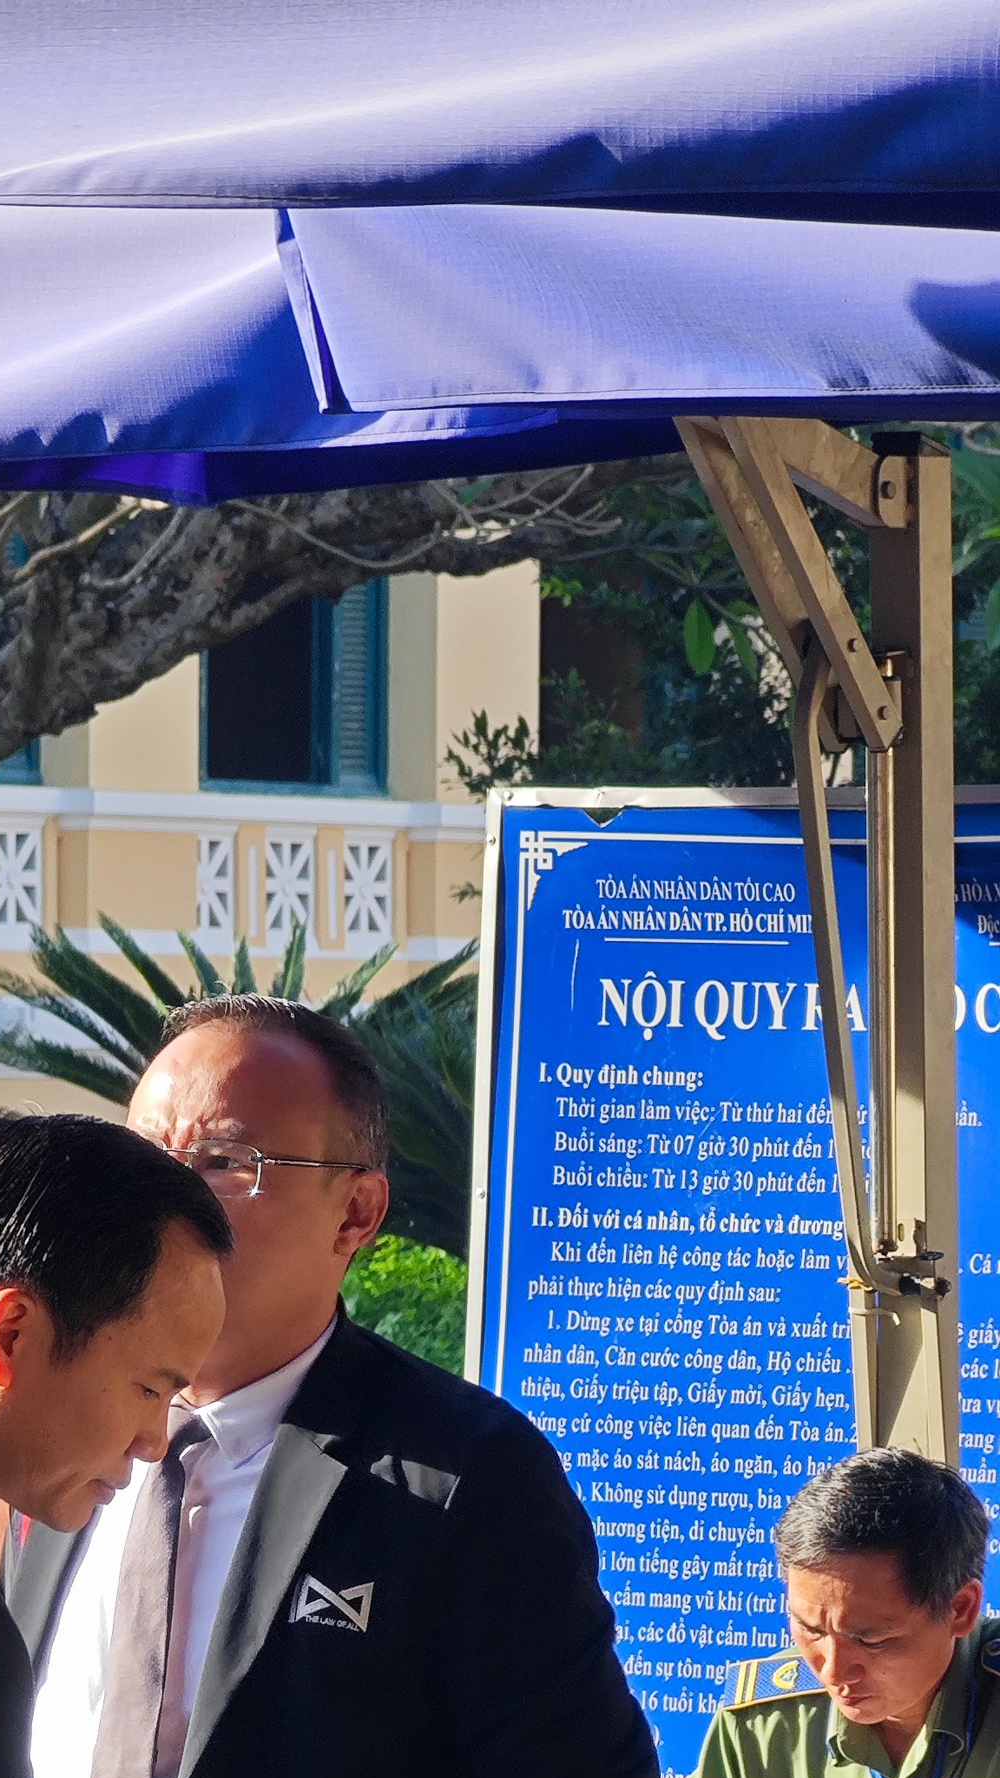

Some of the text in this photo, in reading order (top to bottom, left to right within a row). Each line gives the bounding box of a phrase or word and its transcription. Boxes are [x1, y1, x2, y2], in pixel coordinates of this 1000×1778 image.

[596, 873, 795, 902] TÒA ÁN NHÂN DÂN CAO
[961, 877, 992, 902] HÒA
[562, 904, 785, 933] TÒA ÁN NHÂN DÂN TP. HỒ CHÍ
[598, 971, 686, 1041] NỘI
[694, 980, 797, 1041] QUY
[539, 1062, 704, 1092] I. Quy định chung:
[556, 1097, 802, 1125] Thời gian làm việc: Từ thứ hai
[554, 1127, 822, 1162] Buổi sáng: Từ 07 giờ 30 phút đến
[553, 1161, 826, 1196] Buổi chiều: Từ 13 giờ 30 phút đến
[531, 1202, 844, 1241] II. Đối với cá nhân, tổ chức và đương
[551, 1241, 581, 1262] Khi
[587, 1237, 616, 1263] đến
[622, 1243, 652, 1264] liên
[658, 1244, 677, 1269] hệ
[682, 1245, 722, 1272] công
[727, 1246, 752, 1268] tác
[756, 1247, 795, 1272] hoặc
[800, 1248, 830, 1270] làm
[969, 1253, 991, 1275] Cá
[528, 1275, 782, 1306] phải thực hiện các quy định sau:
[548, 1307, 828, 1340] 1. Dừng xe tại cổng Tòa án và xuất
[523, 1342, 562, 1363] nhân
[566, 1344, 600, 1368] dân,
[605, 1345, 636, 1366] Căn
[640, 1347, 680, 1367] cước
[684, 1348, 723, 1374] công
[727, 1349, 762, 1373] dân,
[767, 1351, 791, 1376] Hộ
[796, 1347, 841, 1373] chiếu
[961, 1357, 988, 1379] các
[521, 1373, 850, 1415] thiệu, Giấy triệu tập, Giấy mời, Giấy hẹn,
[571, 1413, 820, 1443] cứ công việc liên quan đến Tòa
[577, 1449, 609, 1475] mặc
[614, 1448, 632, 1469] áo
[637, 1449, 659, 1470] sát
[664, 1450, 705, 1475] nách,
[711, 1452, 730, 1473] áo
[783, 1455, 802, 1476] áo
[592, 1481, 643, 1508] Không
[647, 1484, 665, 1504] sử
[668, 1485, 708, 1511] dụng
[711, 1492, 753, 1512] rượu,
[757, 1488, 783, 1510] bia
[651, 1518, 685, 1544] tiện,
[689, 1519, 705, 1541] di
[708, 1516, 765, 1548] chuyển
[611, 1550, 636, 1572] lớn
[639, 1547, 679, 1579] tiếng
[681, 1554, 710, 1581] gây
[713, 1550, 743, 1578] mất
[746, 1556, 773, 1582] trật
[614, 1580, 646, 1607] cấm
[649, 1592, 691, 1614] mang
[695, 1590, 714, 1609] vũ
[717, 1590, 744, 1612] khí
[638, 1621, 663, 1642] các
[666, 1617, 686, 1644] đồ
[690, 1623, 713, 1648] vật
[716, 1619, 749, 1647] cấm
[752, 1626, 777, 1648] lưu
[624, 1649, 652, 1676] đến
[656, 1660, 674, 1681] sự
[678, 1660, 702, 1678] tôn
[641, 1686, 694, 1712] 16 tuổi
